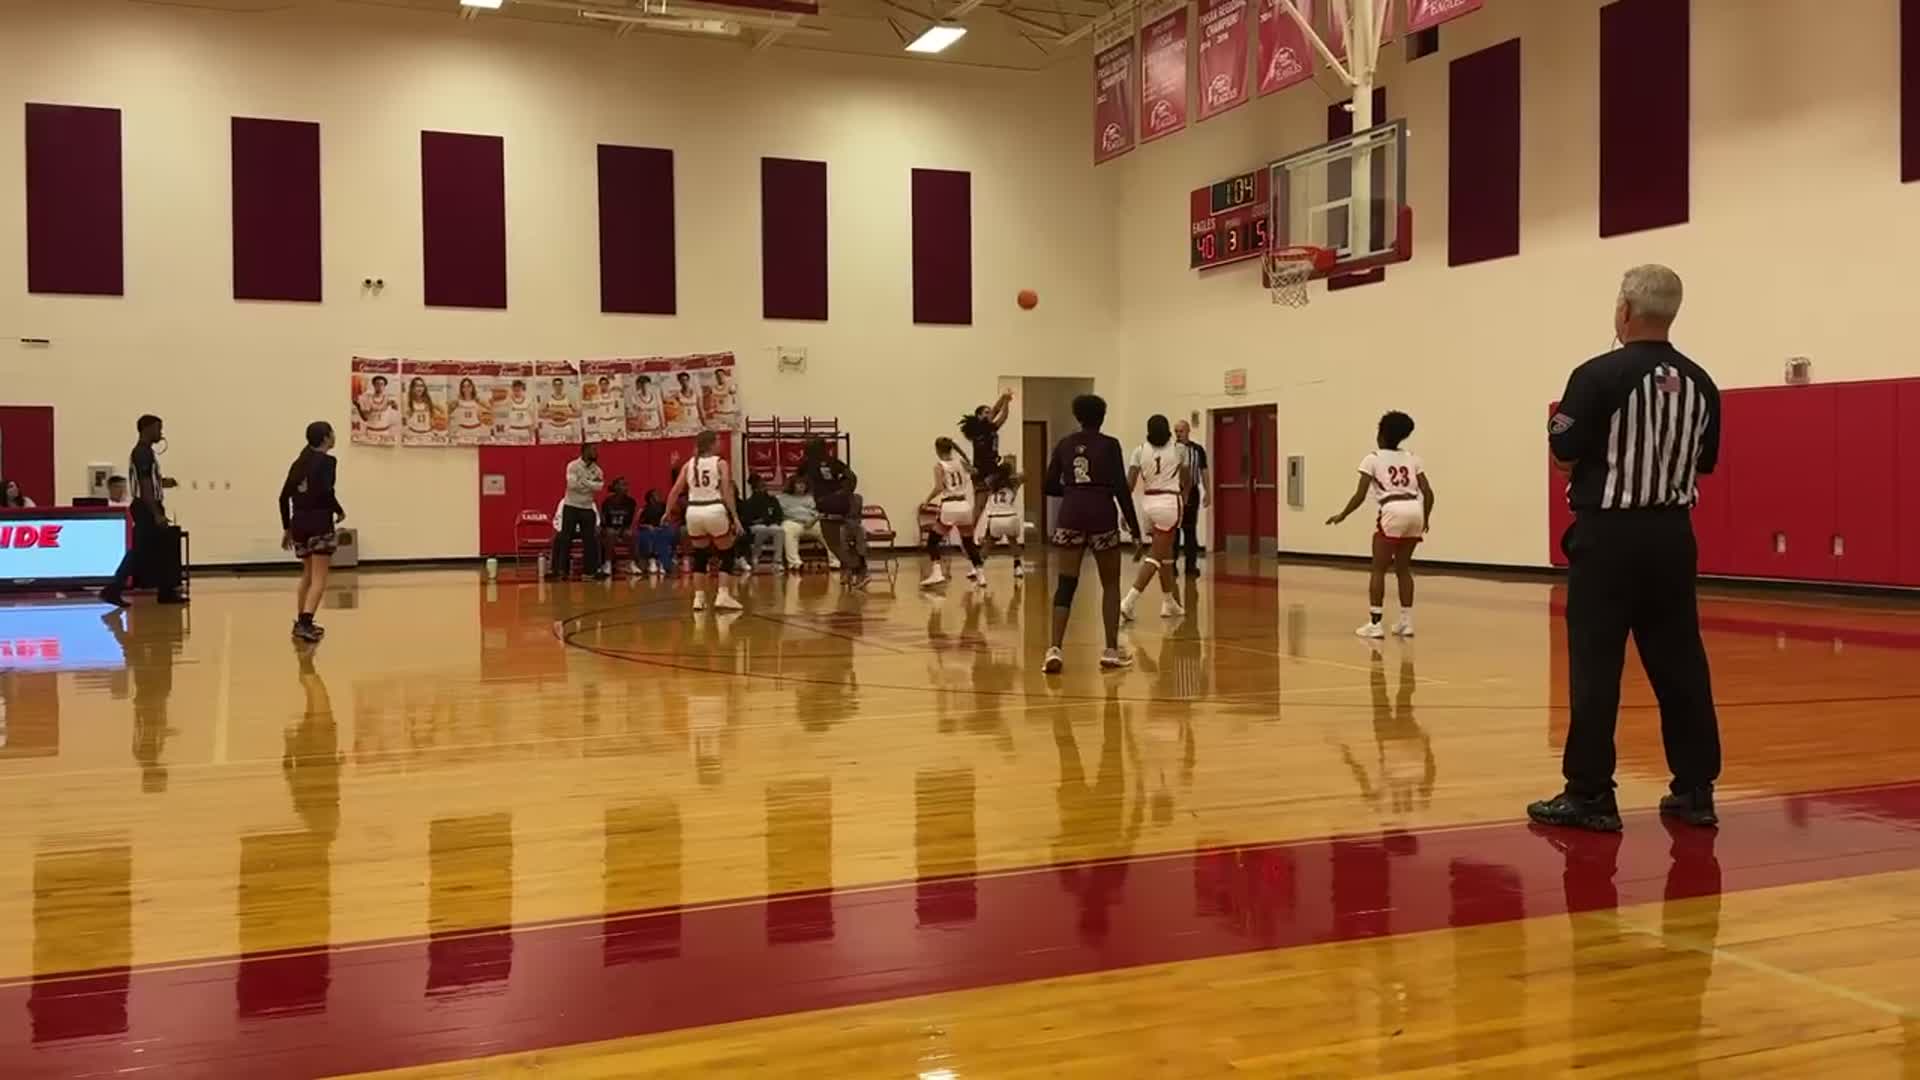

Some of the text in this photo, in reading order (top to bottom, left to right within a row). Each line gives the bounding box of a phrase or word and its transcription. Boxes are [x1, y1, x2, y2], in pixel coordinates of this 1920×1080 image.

[1196, 233, 1215, 260] 40
[1229, 230, 1238, 251] 3
[1073, 456, 1091, 484] 2
[1154, 456, 1161, 475] 1
[694, 469, 710, 488] 15
[950, 471, 963, 487] 11
[1388, 465, 1410, 487] 23
[993, 491, 1007, 505] 12
